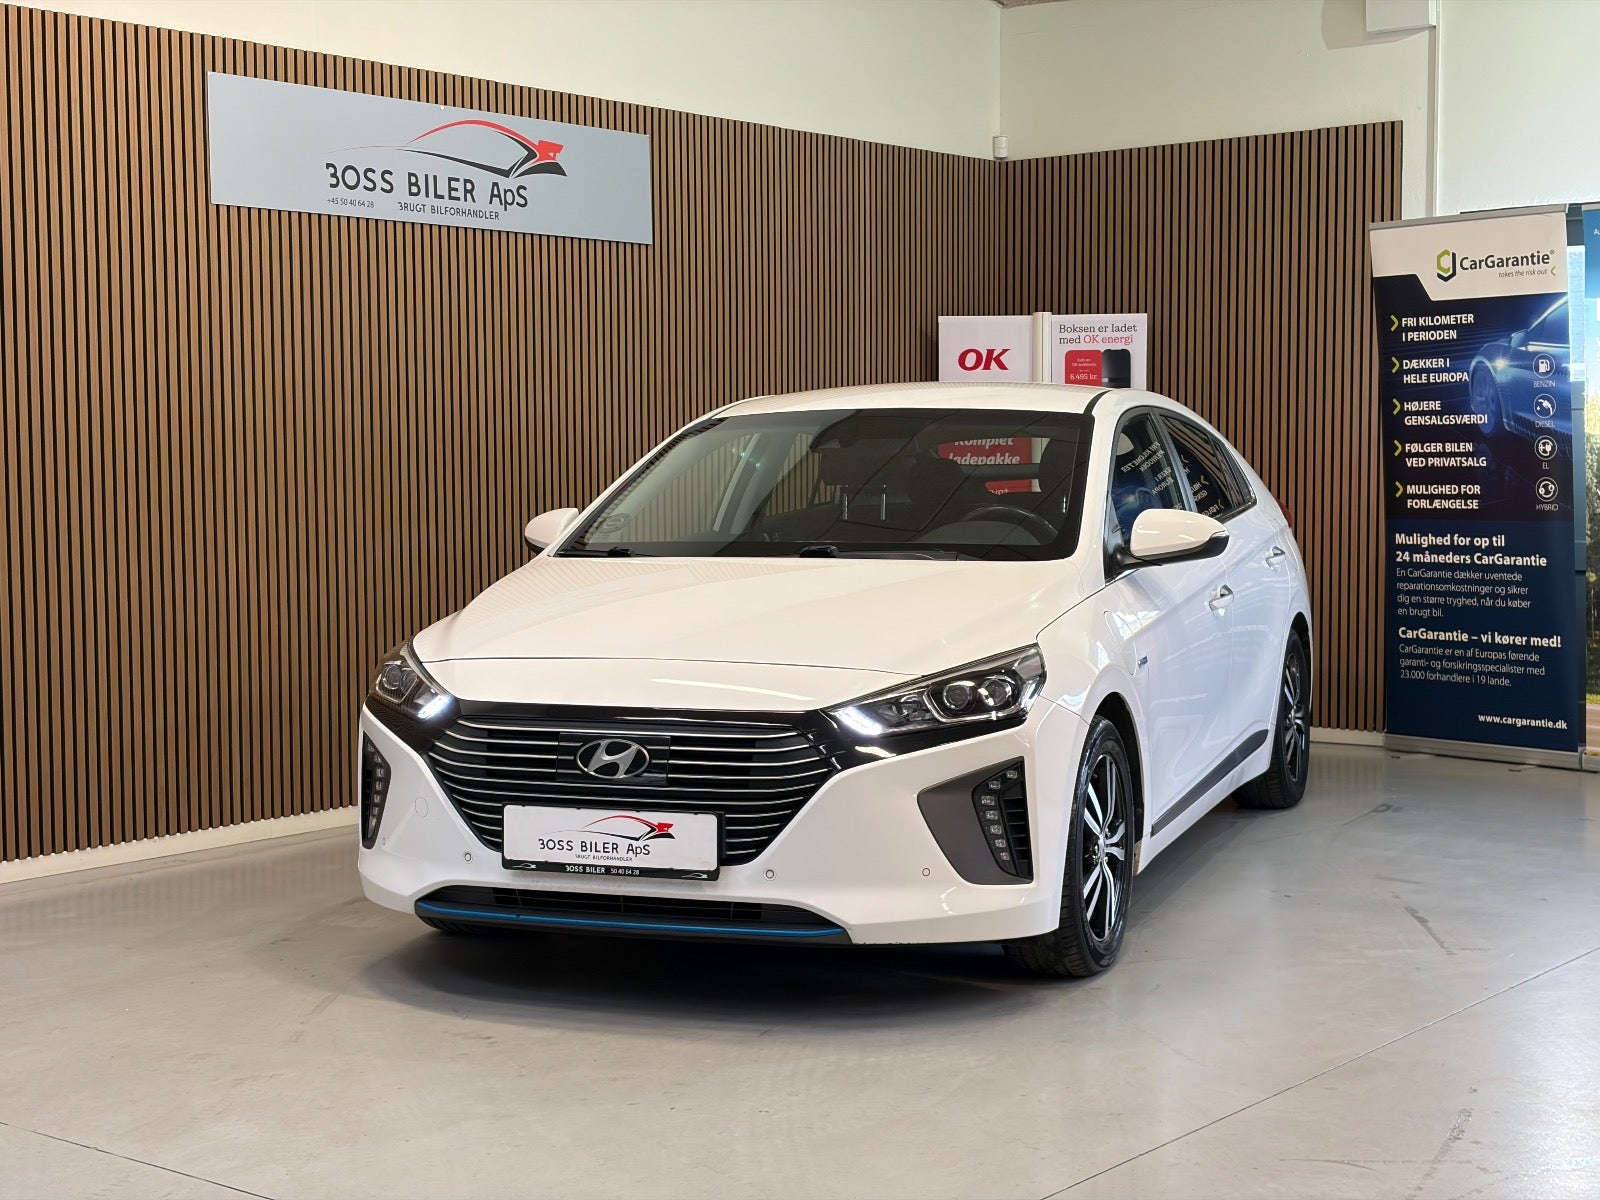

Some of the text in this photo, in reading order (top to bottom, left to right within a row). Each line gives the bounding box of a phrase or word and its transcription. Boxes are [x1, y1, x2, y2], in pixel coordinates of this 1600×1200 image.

[407, 172, 476, 203] BILER
[488, 182, 528, 212] ApS
[326, 196, 339, 205] +45
[430, 202, 500, 221] BILFORHANDLER
[1460, 250, 1550, 271] CarGarantie
[1401, 314, 1474, 328] FRI KILOMETER
[1059, 324, 1096, 333] Boksen
[1111, 324, 1137, 332] ladet
[1059, 335, 1133, 346] med OK energi
[1407, 330, 1457, 342] PERIODEN
[958, 348, 1012, 371] OK
[1403, 358, 1444, 370] DÆKKER
[1403, 372, 1470, 384] HELE EUROPA
[1533, 380, 1556, 388] BENZIN
[1404, 400, 1442, 412] HØJERE
[1404, 414, 1488, 426] GENSALGSVÆRDI
[1405, 442, 1473, 453] FØLGER BILEN
[1405, 457, 1487, 468] VED PRIVATSALG
[1542, 462, 1550, 470] EL
[1406, 484, 1481, 495] MULIGHED FOR
[1407, 499, 1479, 510] FORLÆNGELSE
[1395, 532, 1505, 549] Mulighed for op til
[1395, 550, 1547, 566] 24 måneders CarGarantie
[1396, 568, 1522, 581] En CarGarantie dækker uventede
[1397, 582, 1529, 596] reparationsomkostninger og sikrer
[1397, 594, 1409, 604] dig
[1423, 595, 1445, 604] større
[1446, 596, 1479, 607] tryghed,
[1481, 597, 1493, 607] når
[1495, 598, 1506, 607] du
[1507, 598, 1531, 608] køber
[1397, 607, 1444, 618] en brugt bil.
[1398, 626, 1469, 642] CarGarantie
[1481, 632, 1492, 644] vi
[1494, 632, 1527, 646] kører
[1530, 635, 1562, 648] med!
[1399, 644, 1444, 656] CarGarantie
[1454, 649, 1465, 657] en
[1466, 648, 1474, 658] af
[1475, 649, 1507, 661] Europas
[1508, 651, 1540, 662] førende
[1400, 658, 1546, 676] garanti- og forsikringsspecialister med
[1400, 670, 1426, 680] 23.000
[1426, 670, 1471, 684] forhandlere
[1476, 675, 1486, 685] 19
[1487, 676, 1512, 687] lande.
[1478, 714, 1568, 730] www.cargarantie.dk
[580, 840, 619, 854] BILER
[626, 843, 651, 857] ApS
